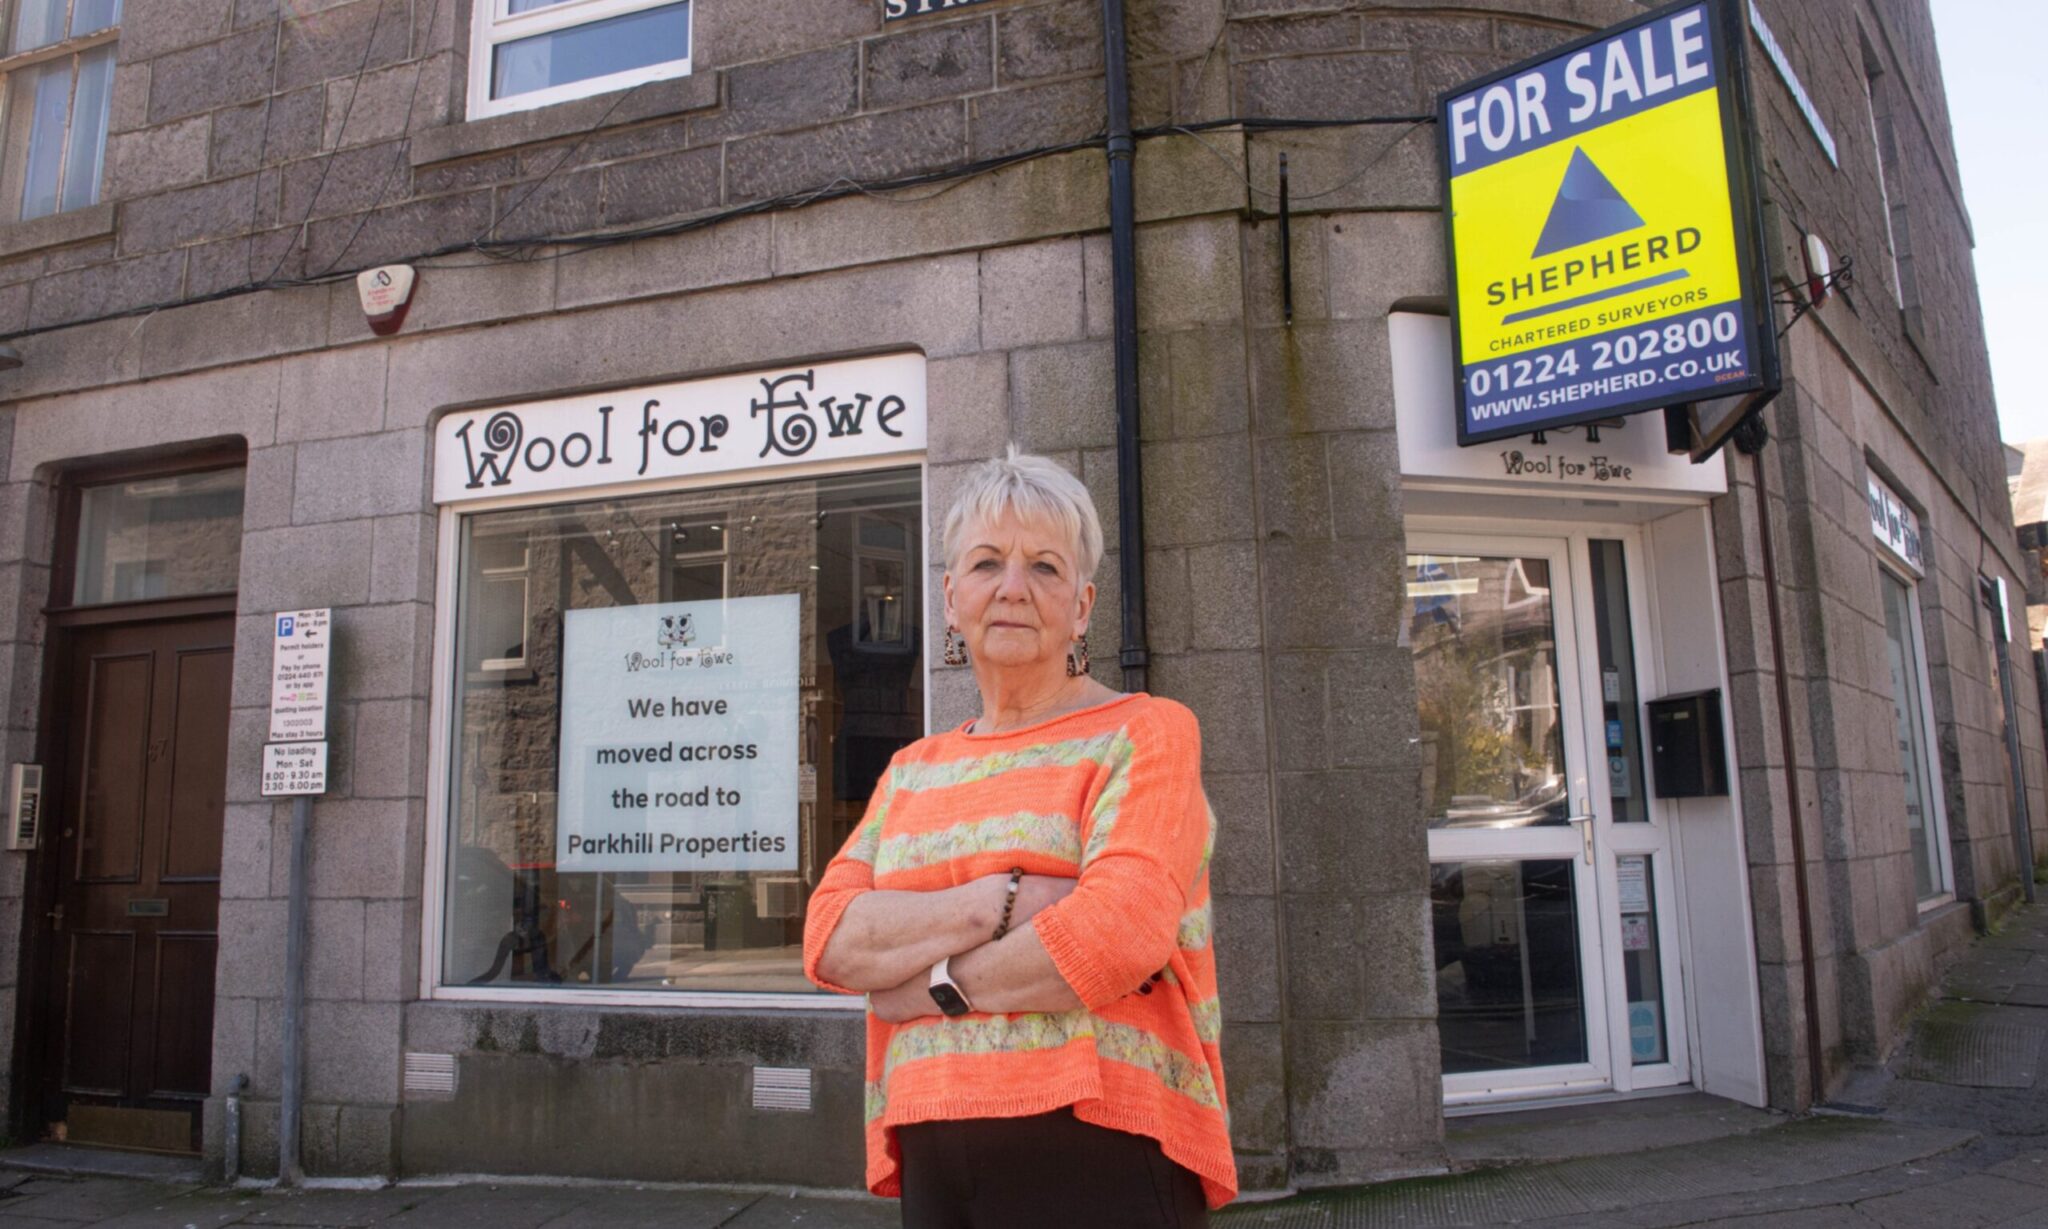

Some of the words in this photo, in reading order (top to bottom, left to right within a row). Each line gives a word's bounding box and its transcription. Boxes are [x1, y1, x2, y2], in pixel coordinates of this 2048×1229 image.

[1451, 71, 1552, 165] FOR
[1564, 8, 1709, 123] SALE
[1486, 226, 1702, 307] SHEPHERD
[1489, 317, 1591, 352] CHARTERED
[1596, 287, 1709, 326] SURVEYORS
[1469, 348, 1580, 397] 01224
[1591, 311, 1738, 370] 202800
[1470, 349, 1743, 421] WWW.SHEPHERD.CO.UK
[455, 405, 614, 489] Wool
[637, 399, 730, 475] for
[750, 369, 906, 458] Ewe
[1499, 450, 1552, 475] Wool
[1558, 456, 1586, 480] for
[1589, 456, 1632, 481] Ewe
[298, 611, 312, 619] Mon
[280, 643, 300, 651] Permit
[624, 651, 665, 672] Wool
[670, 650, 693, 671] for
[698, 646, 734, 669] Ewe
[627, 698, 665, 719] We
[671, 696, 728, 717] have
[274, 748, 285, 756] No
[287, 746, 317, 755] loading
[276, 761, 293, 769] Mon
[299, 759, 313, 767] Sat
[596, 741, 673, 765] moved
[679, 743, 758, 761] across
[611, 787, 648, 808] the
[654, 785, 709, 808] road
[715, 787, 741, 806] to
[568, 833, 653, 855] Parkhill
[659, 831, 786, 858] Properties
